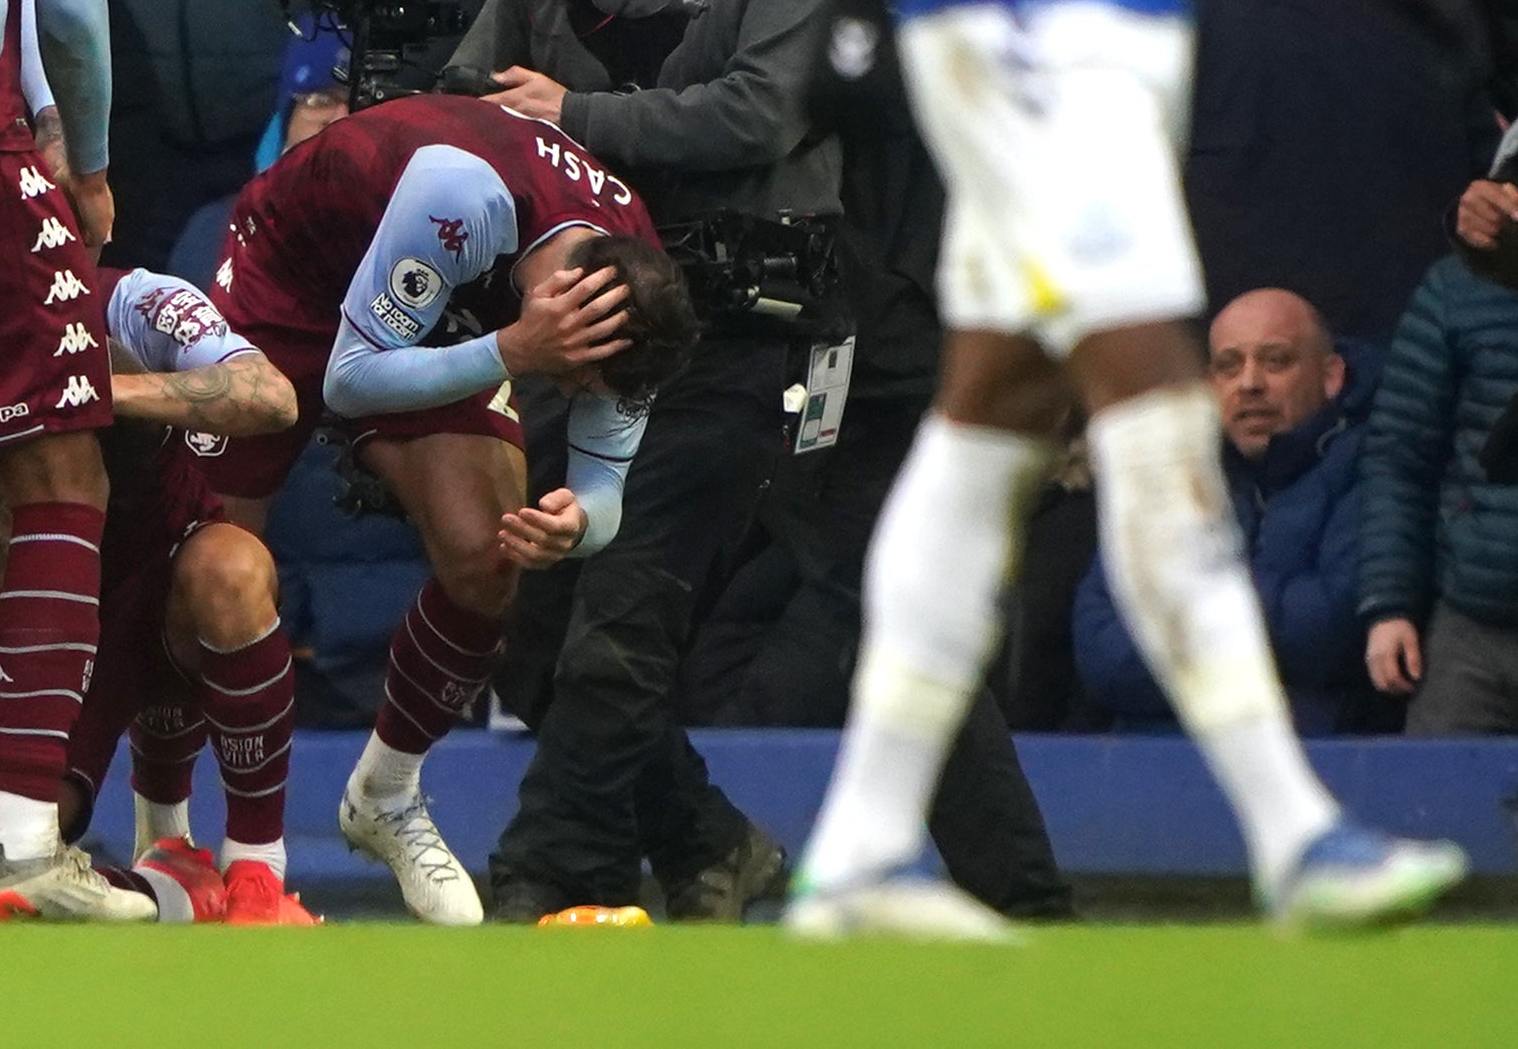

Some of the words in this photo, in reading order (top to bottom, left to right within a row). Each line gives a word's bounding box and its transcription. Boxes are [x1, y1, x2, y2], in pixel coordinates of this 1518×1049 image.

[535, 136, 632, 205] CASH
[375, 292, 393, 310] No
[390, 307, 419, 332] room
[383, 313, 416, 340] racism
